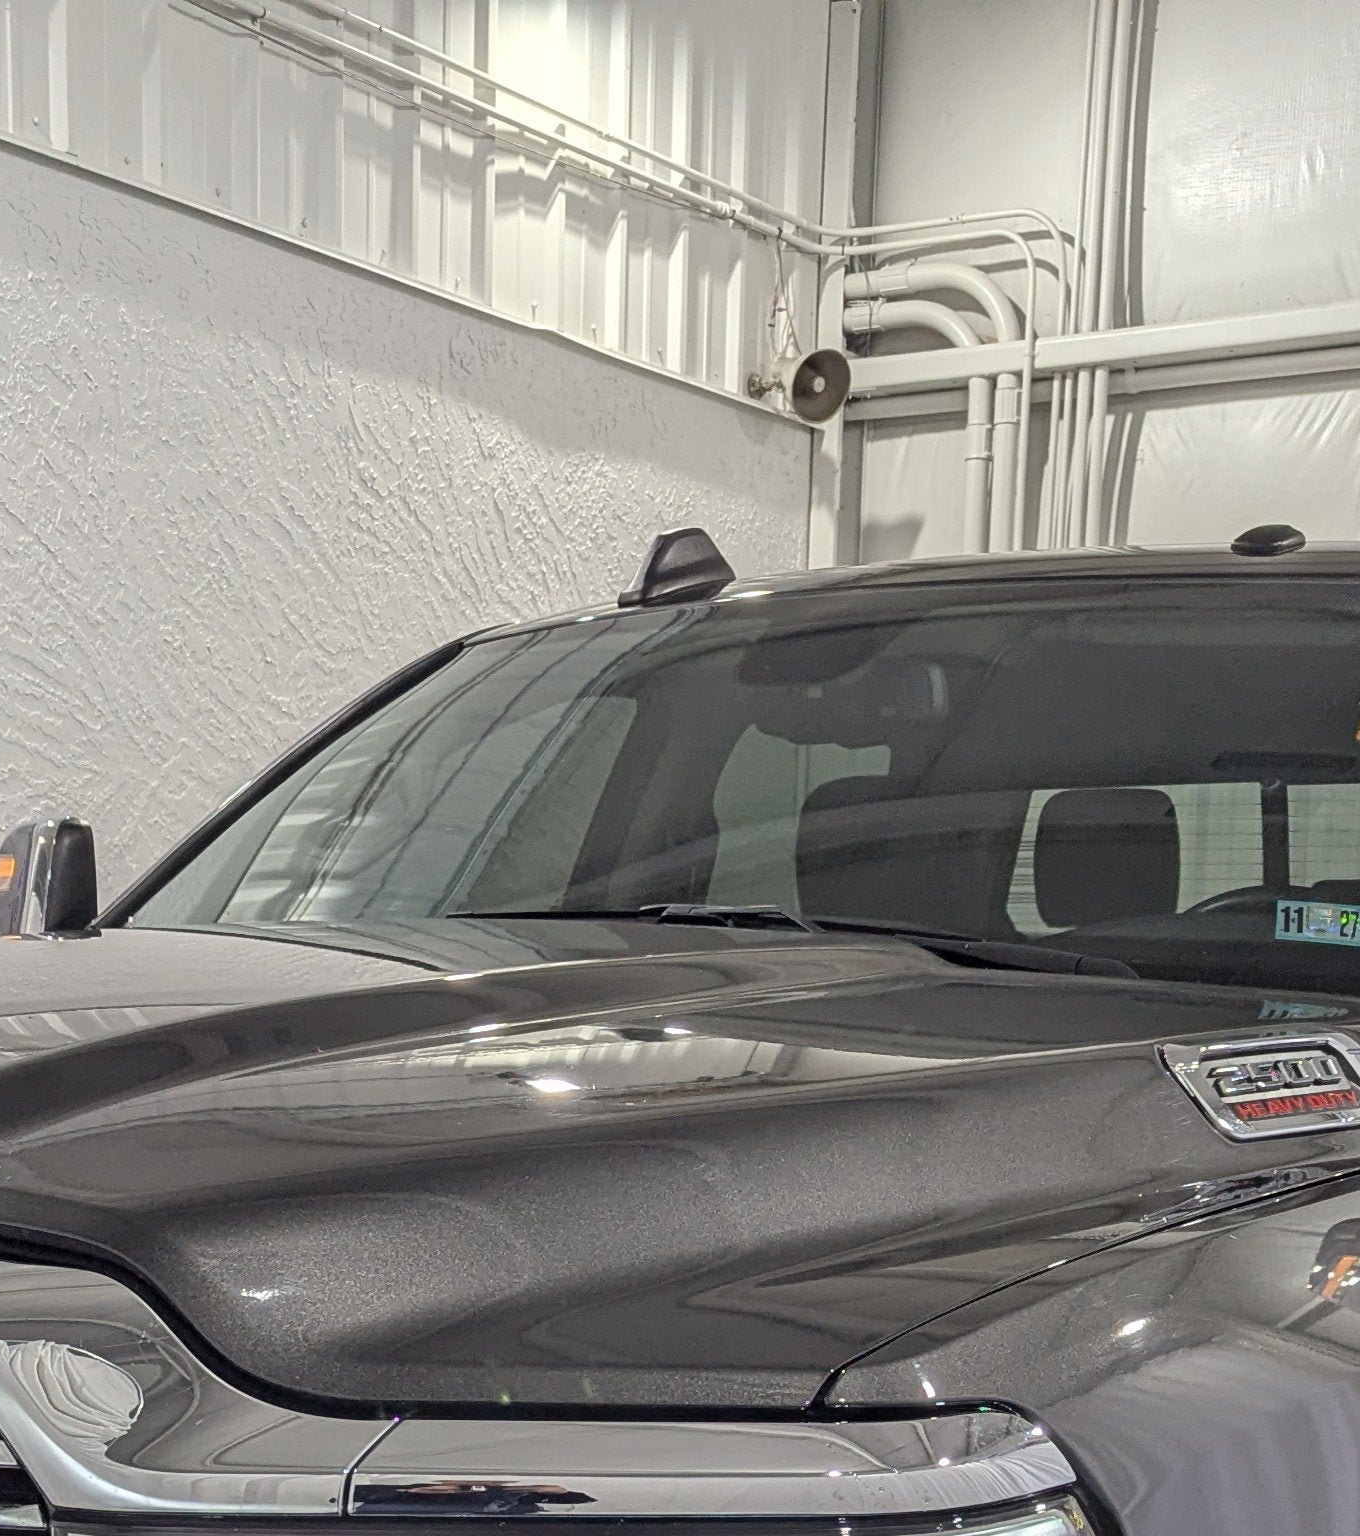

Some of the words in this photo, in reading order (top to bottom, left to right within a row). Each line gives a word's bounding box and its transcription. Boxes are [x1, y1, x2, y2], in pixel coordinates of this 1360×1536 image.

[1206, 1056, 1342, 1099] 2500
[1233, 1096, 1304, 1120] HEAVY
[1309, 1090, 1359, 1110] DUTY
